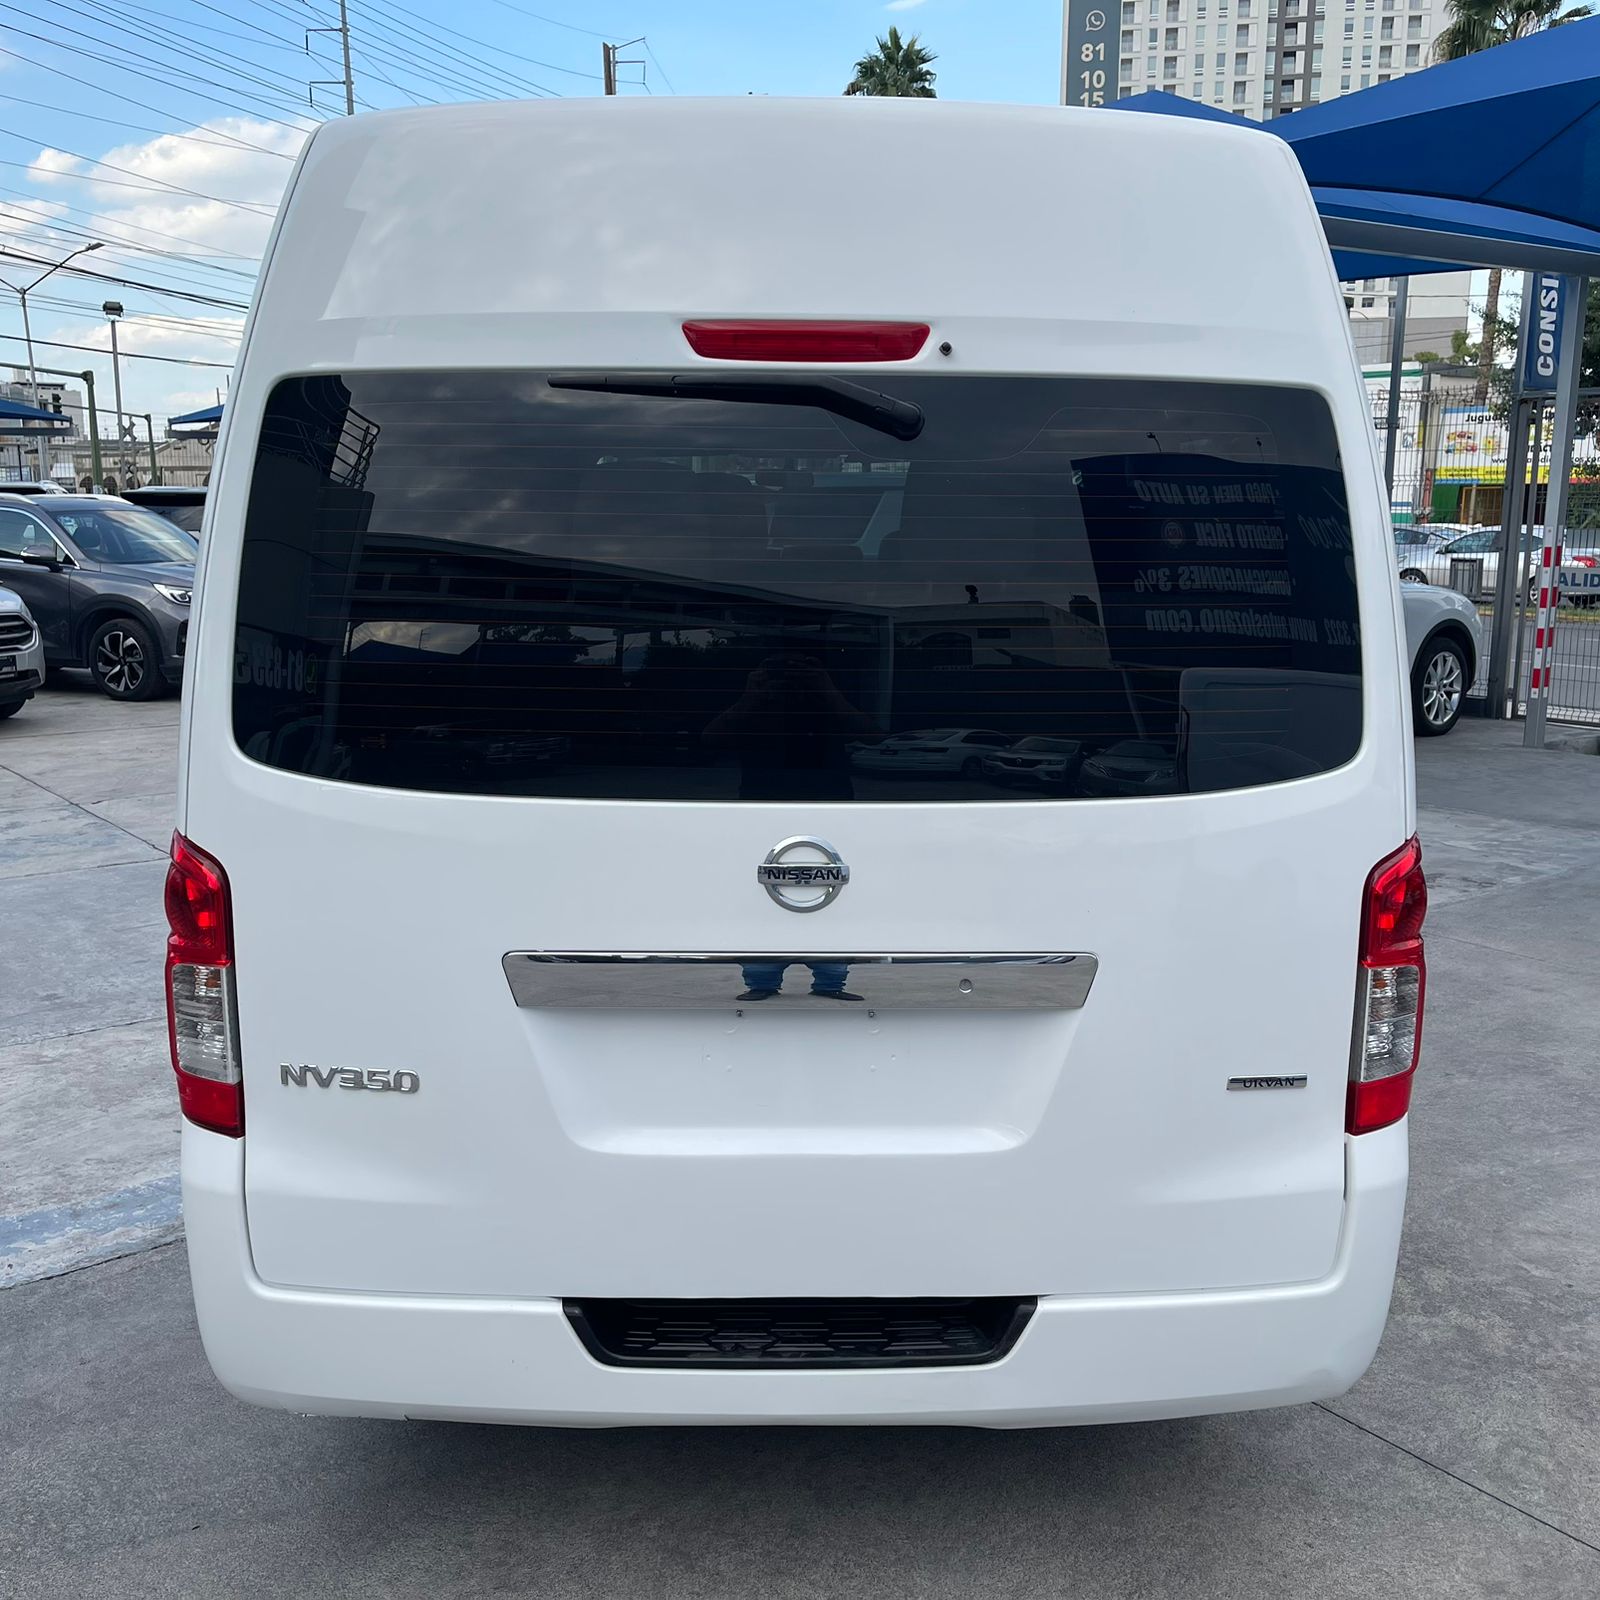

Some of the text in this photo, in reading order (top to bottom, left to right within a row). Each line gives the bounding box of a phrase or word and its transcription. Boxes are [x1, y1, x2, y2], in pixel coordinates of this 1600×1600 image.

[1081, 42, 1105, 62] 81
[1080, 70, 1105, 89] 10
[1080, 91, 1104, 107] 15
[767, 869, 840, 881] NISSAN
[279, 1062, 420, 1095] NV350
[1242, 1077, 1296, 1088] URVAN
